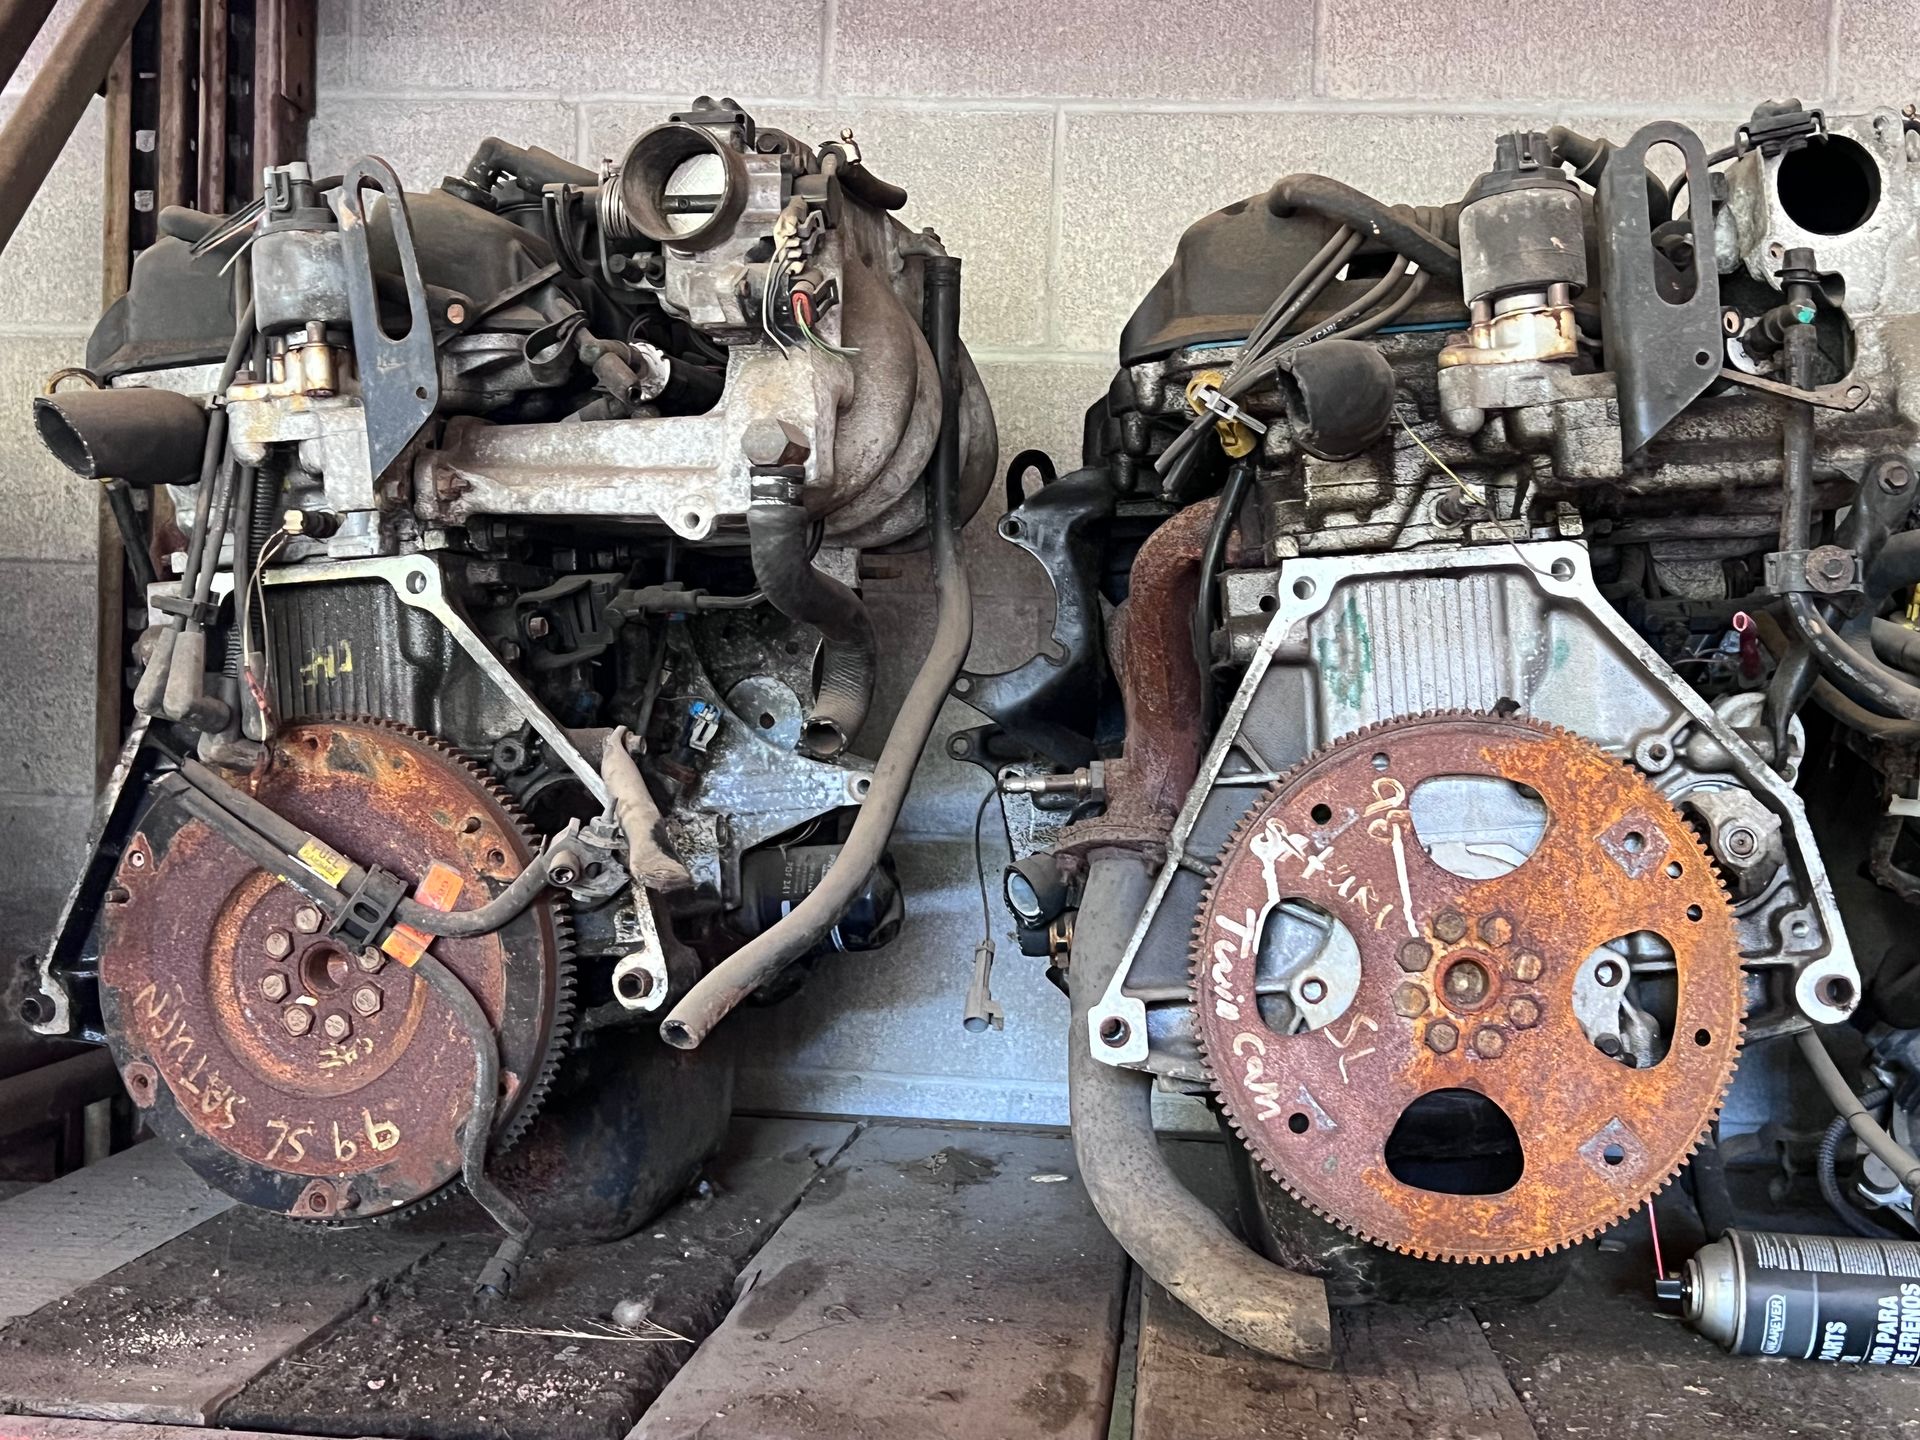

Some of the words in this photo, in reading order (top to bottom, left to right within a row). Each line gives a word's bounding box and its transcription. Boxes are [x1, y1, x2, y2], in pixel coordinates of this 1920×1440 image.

[1323, 1012, 1379, 1084] SL
[264, 1118, 315, 1163] SL
[1766, 1299, 1784, 1352] WEAREVER
[1876, 1295, 1899, 1345] PARA
[1897, 1283, 1920, 1352] FRENOS
